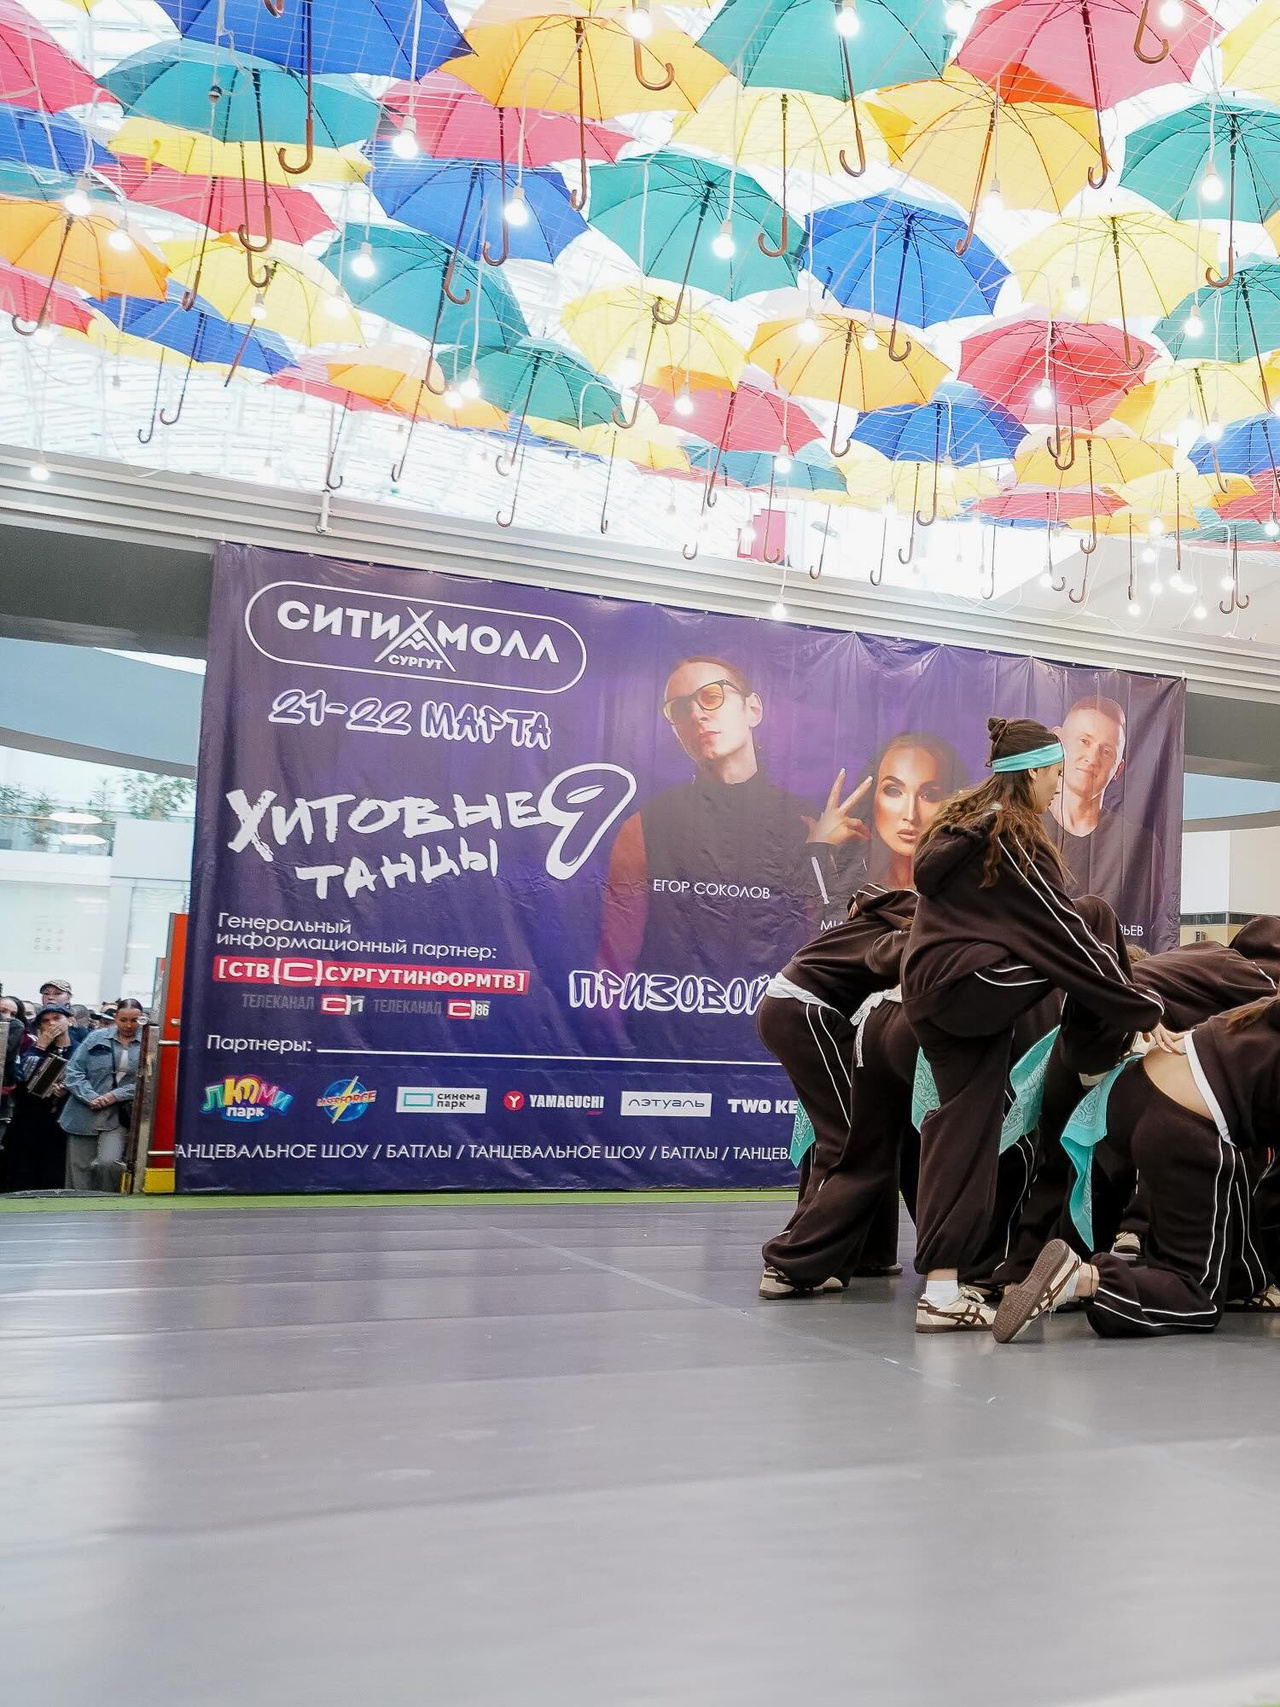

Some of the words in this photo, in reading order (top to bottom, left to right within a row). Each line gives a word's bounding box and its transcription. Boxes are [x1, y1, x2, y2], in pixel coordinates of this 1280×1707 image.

[277, 600, 397, 641] СИТИ
[438, 624, 560, 664] МОЛЛ
[388, 653, 443, 671] СУРГУТ
[268, 689, 411, 736] 21-22
[420, 700, 552, 750] МАРТА
[653, 879, 690, 894] ЕГОР
[694, 882, 771, 900] СОКОЛОВ
[218, 912, 352, 935] Генеральный
[216, 932, 407, 957] информационный
[411, 942, 498, 962] партнер:
[568, 969, 771, 1016] ПРИЗОВОЙ
[241, 993, 315, 1011] ТЕЛЕКАНАЛ
[374, 998, 442, 1015] ТЕЛЕКАНАЛ
[206, 1035, 313, 1055] Партнеры:
[436, 1100, 467, 1110] парк
[437, 1092, 482, 1103] синема
[529, 1093, 605, 1110] YAMAGUCHI
[727, 1098, 772, 1114] TWO
[226, 1106, 266, 1120] парк
[321, 1144, 369, 1160] ШОУ
[386, 1144, 452, 1159] БАТТЛЫ
[468, 1145, 601, 1162] ТАНЦЕВАЛЬНОЕ
[605, 1145, 646, 1160] ШОУ
[661, 1146, 718, 1160] БАТТЛЫ
